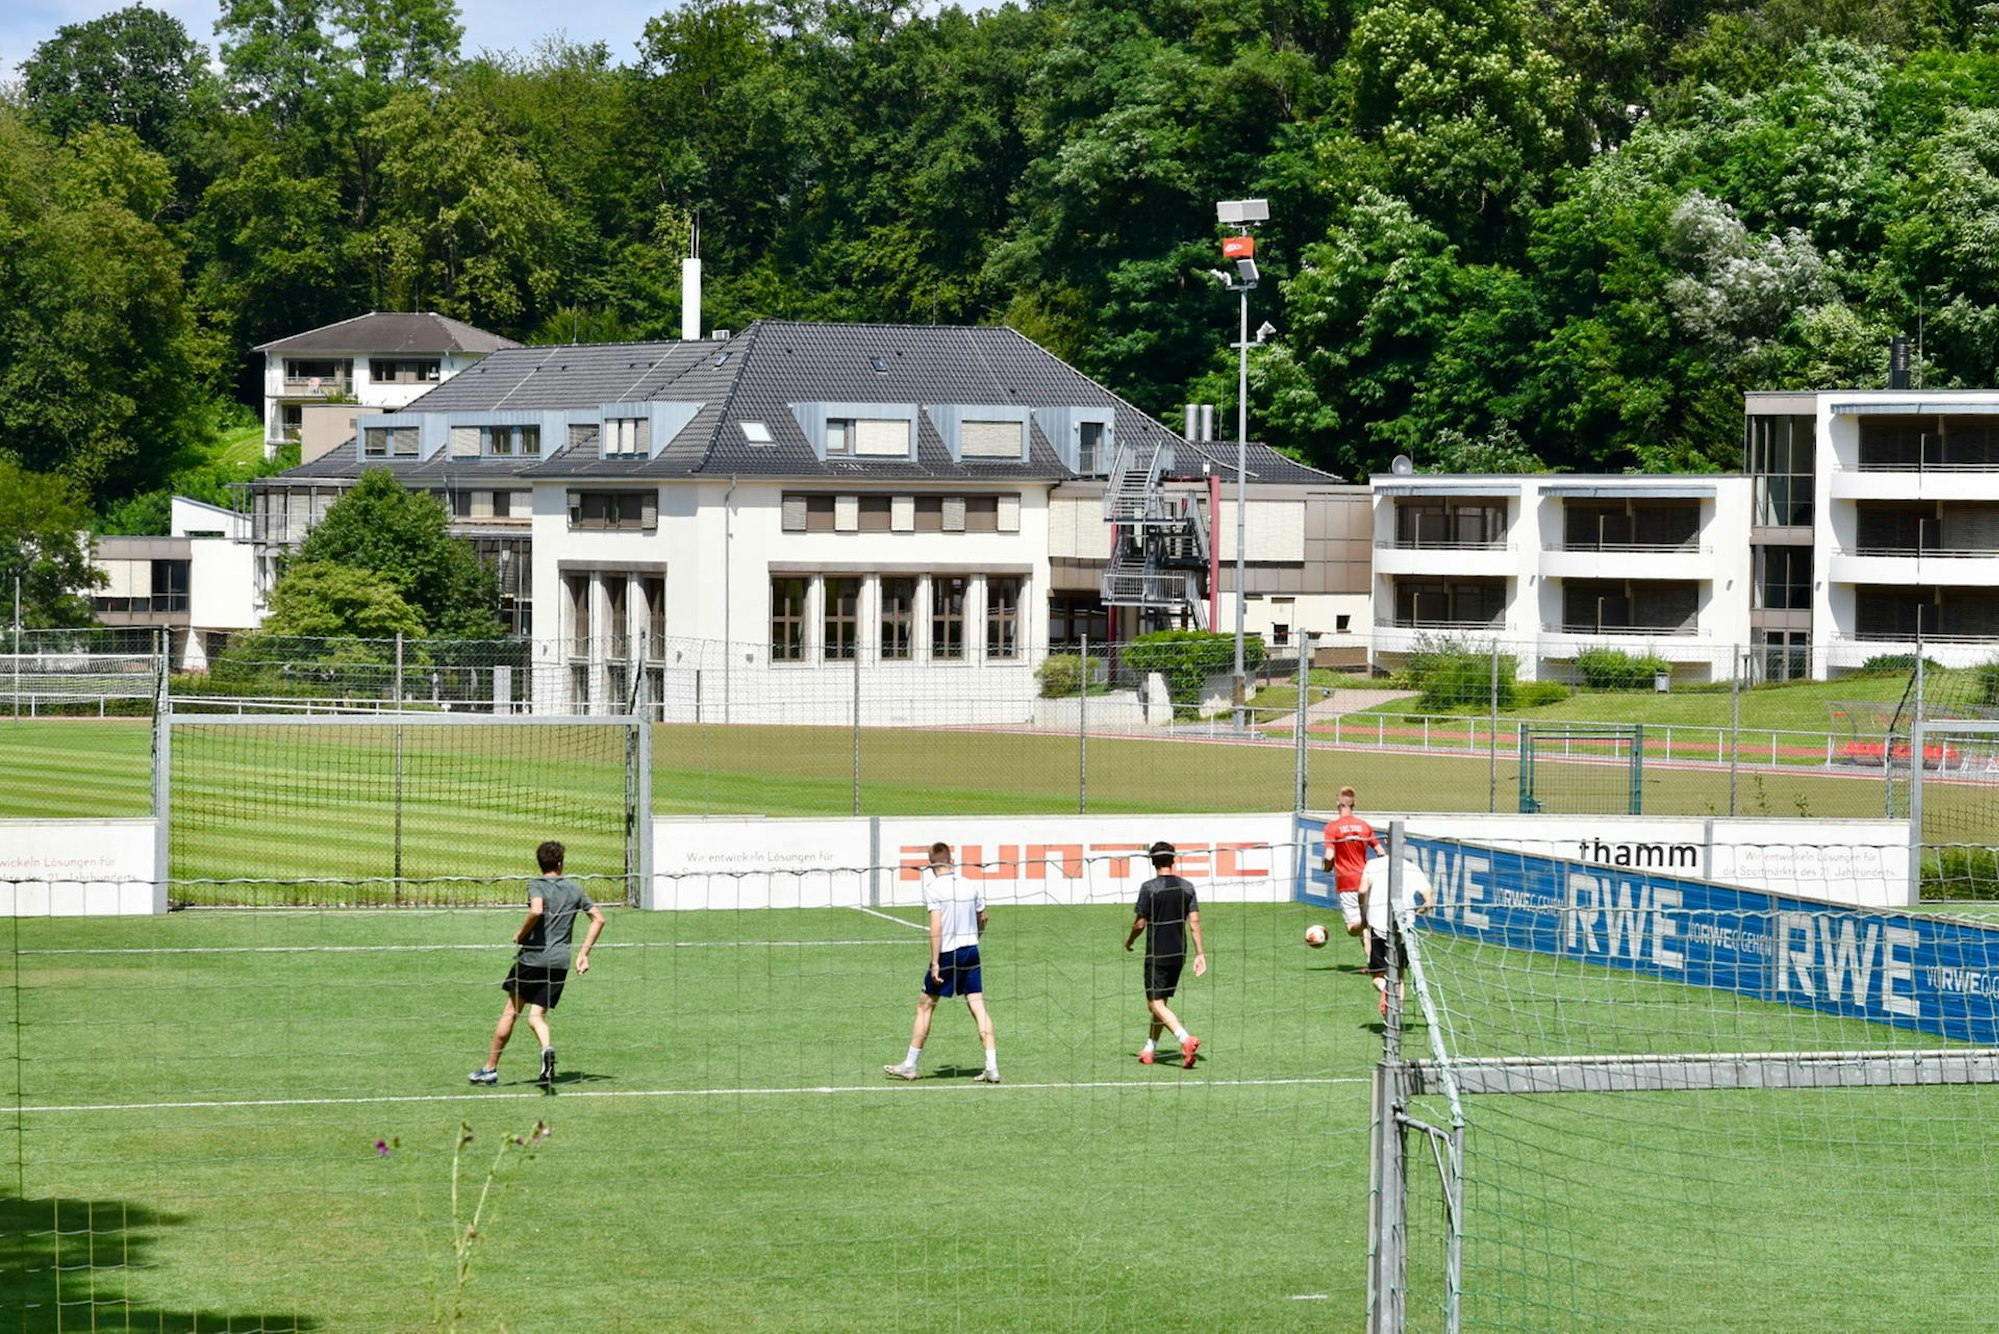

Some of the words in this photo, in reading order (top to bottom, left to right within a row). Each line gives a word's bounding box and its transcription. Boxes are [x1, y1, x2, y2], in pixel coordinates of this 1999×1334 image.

[708, 852, 765, 863] entwickeln
[1579, 837, 1697, 867] thamm
[1568, 872, 1684, 969] RWE
[1778, 910, 1920, 1018] RWE
